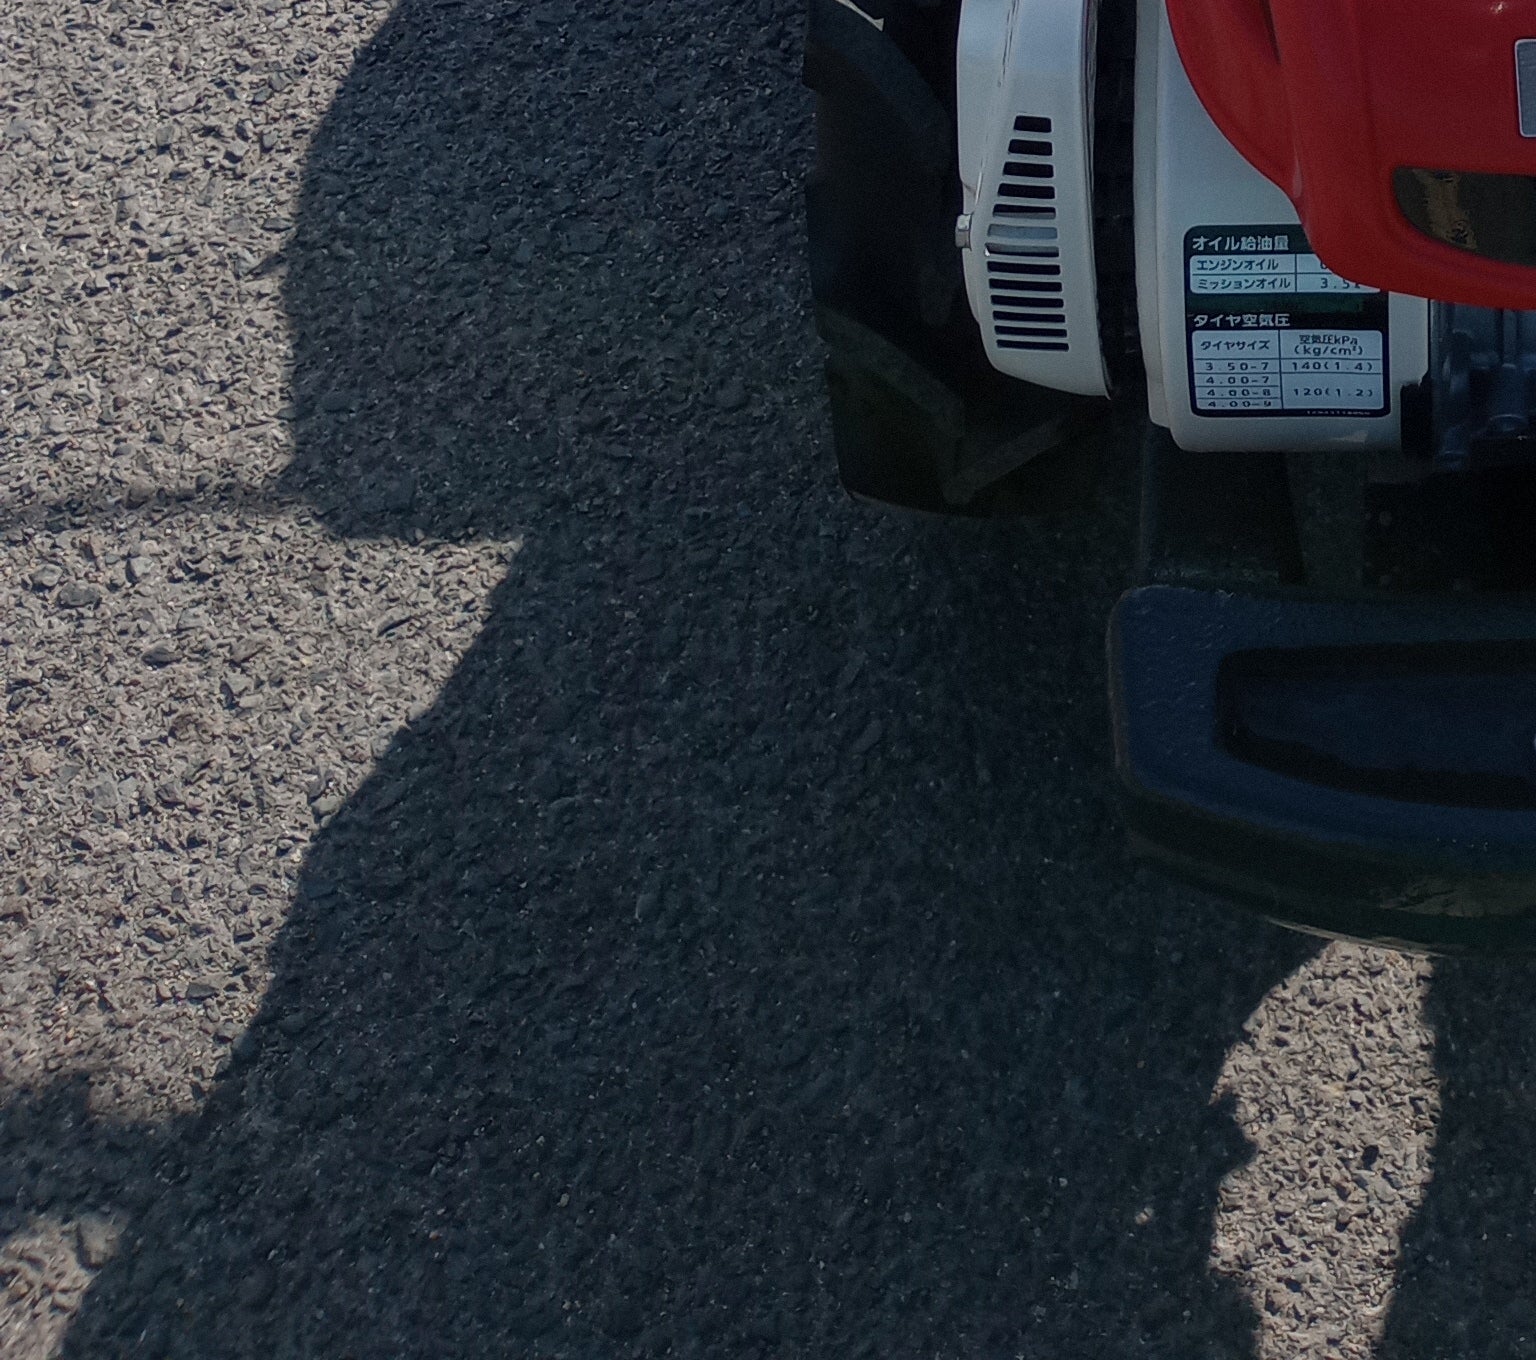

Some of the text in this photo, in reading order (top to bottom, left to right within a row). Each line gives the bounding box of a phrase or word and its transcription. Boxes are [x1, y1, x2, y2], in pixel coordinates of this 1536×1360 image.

[1192, 235, 1289, 251] オイル給油量
[1196, 259, 1279, 271] エンジンオイル
[1197, 278, 1291, 290] ミッションオイル
[1193, 313, 1290, 327] タイヤ空気圧
[1200, 340, 1270, 350] タイヤサイズ
